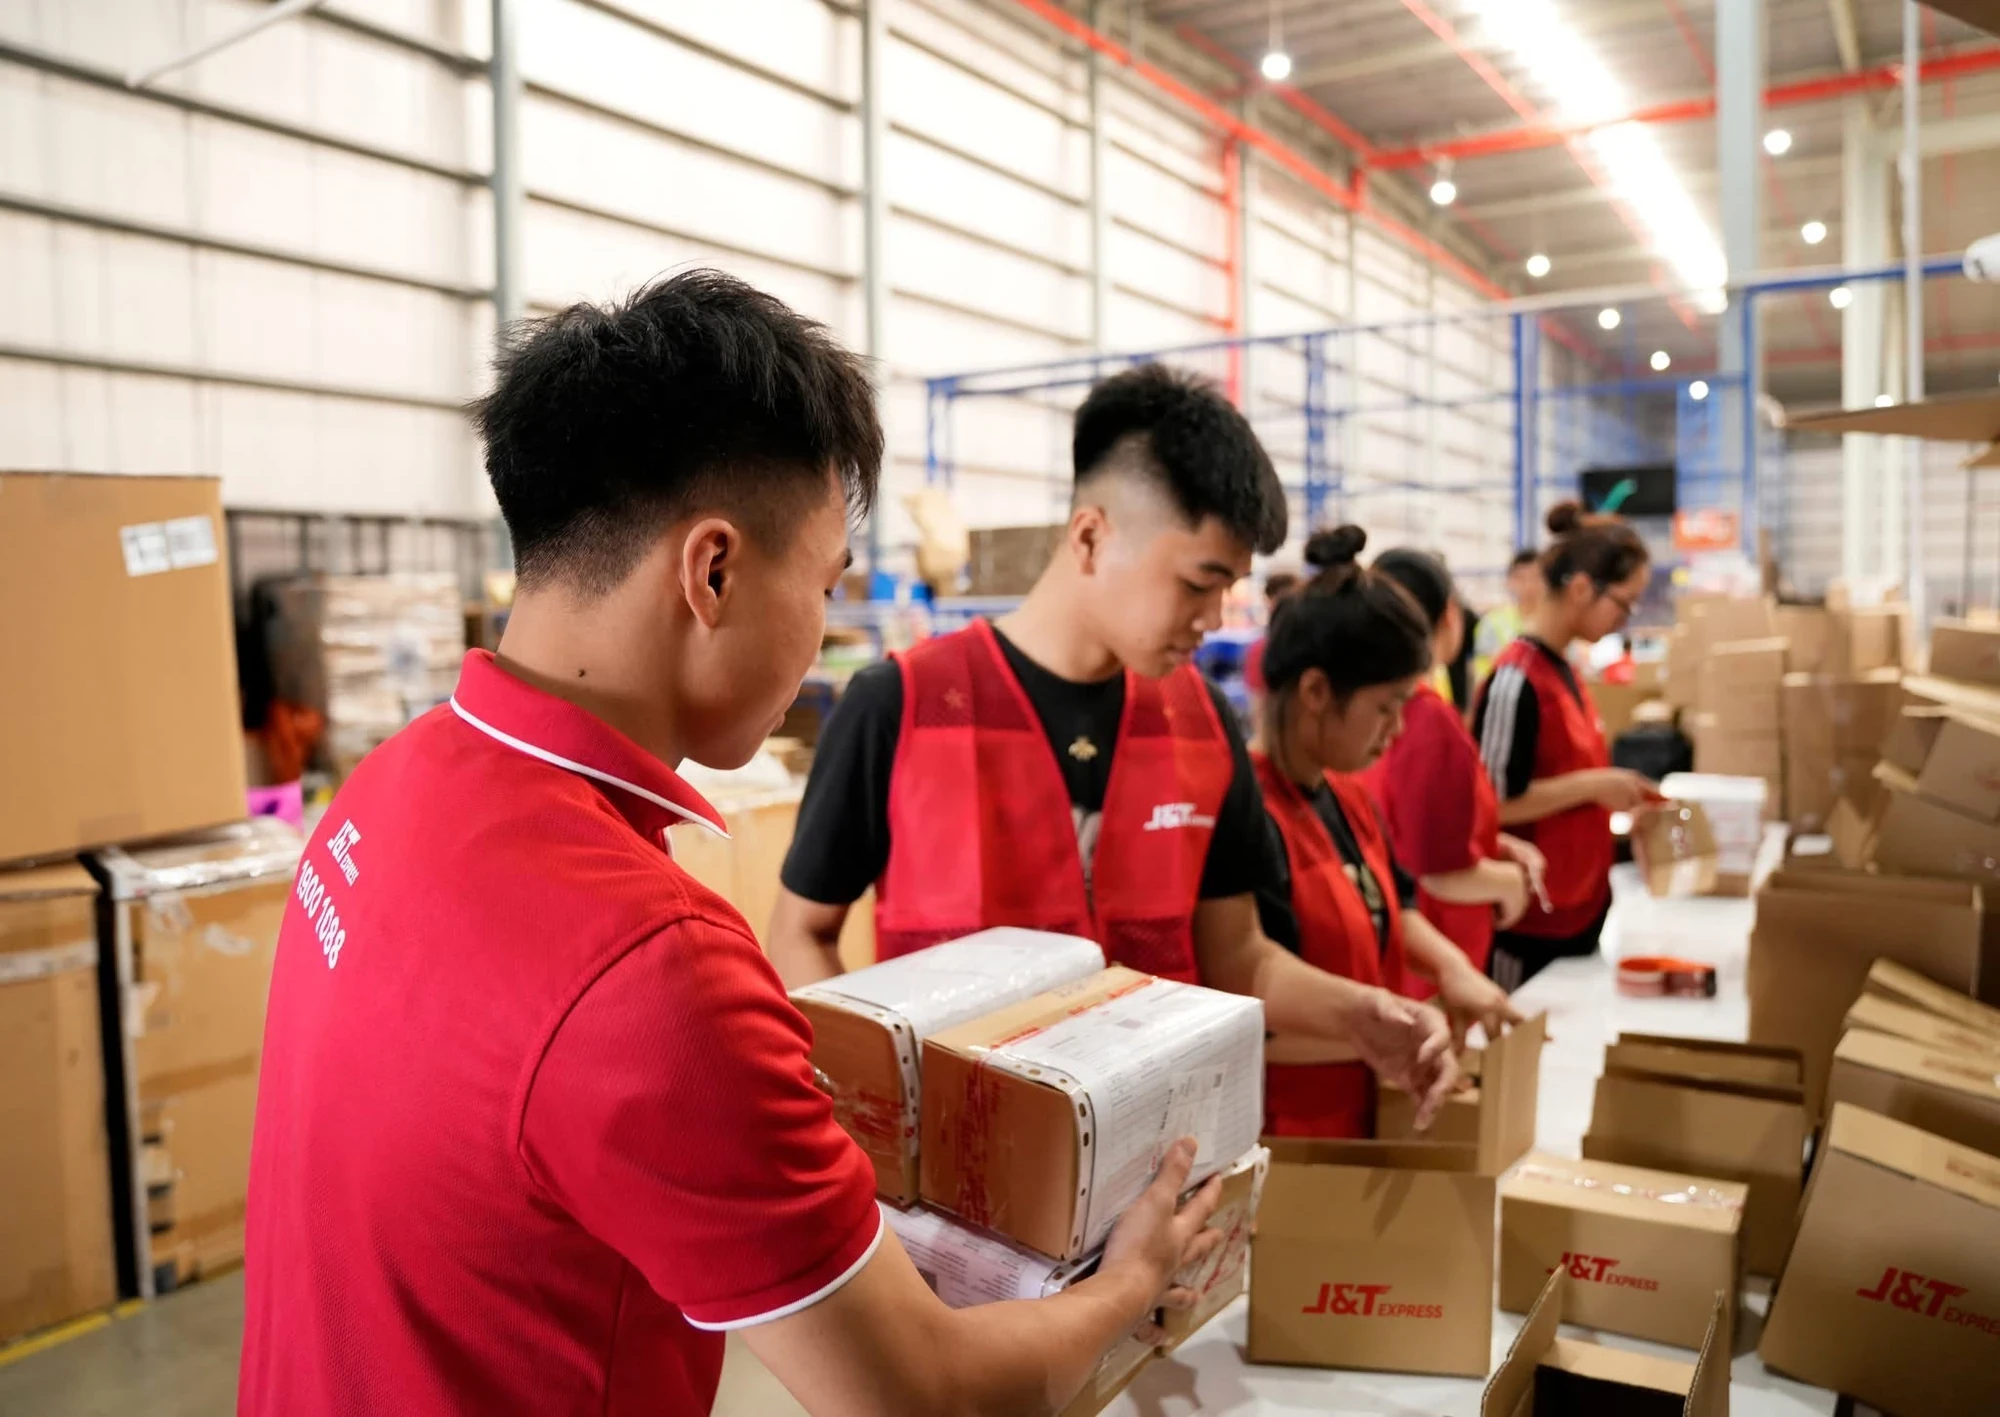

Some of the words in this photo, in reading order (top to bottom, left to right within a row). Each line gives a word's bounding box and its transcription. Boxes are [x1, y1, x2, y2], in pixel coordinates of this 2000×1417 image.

[1143, 802, 1197, 831] J&T
[327, 820, 361, 862] J&T
[296, 859, 325, 919] 1900
[315, 896, 346, 969] 1088
[1301, 1282, 1393, 1316] J&T
[1378, 1303, 1444, 1319] EXPRESS
[1605, 1273, 1660, 1292] EXPRESS
[1855, 1266, 1969, 1317] J&T
[1943, 1306, 2000, 1336] EXPRE
